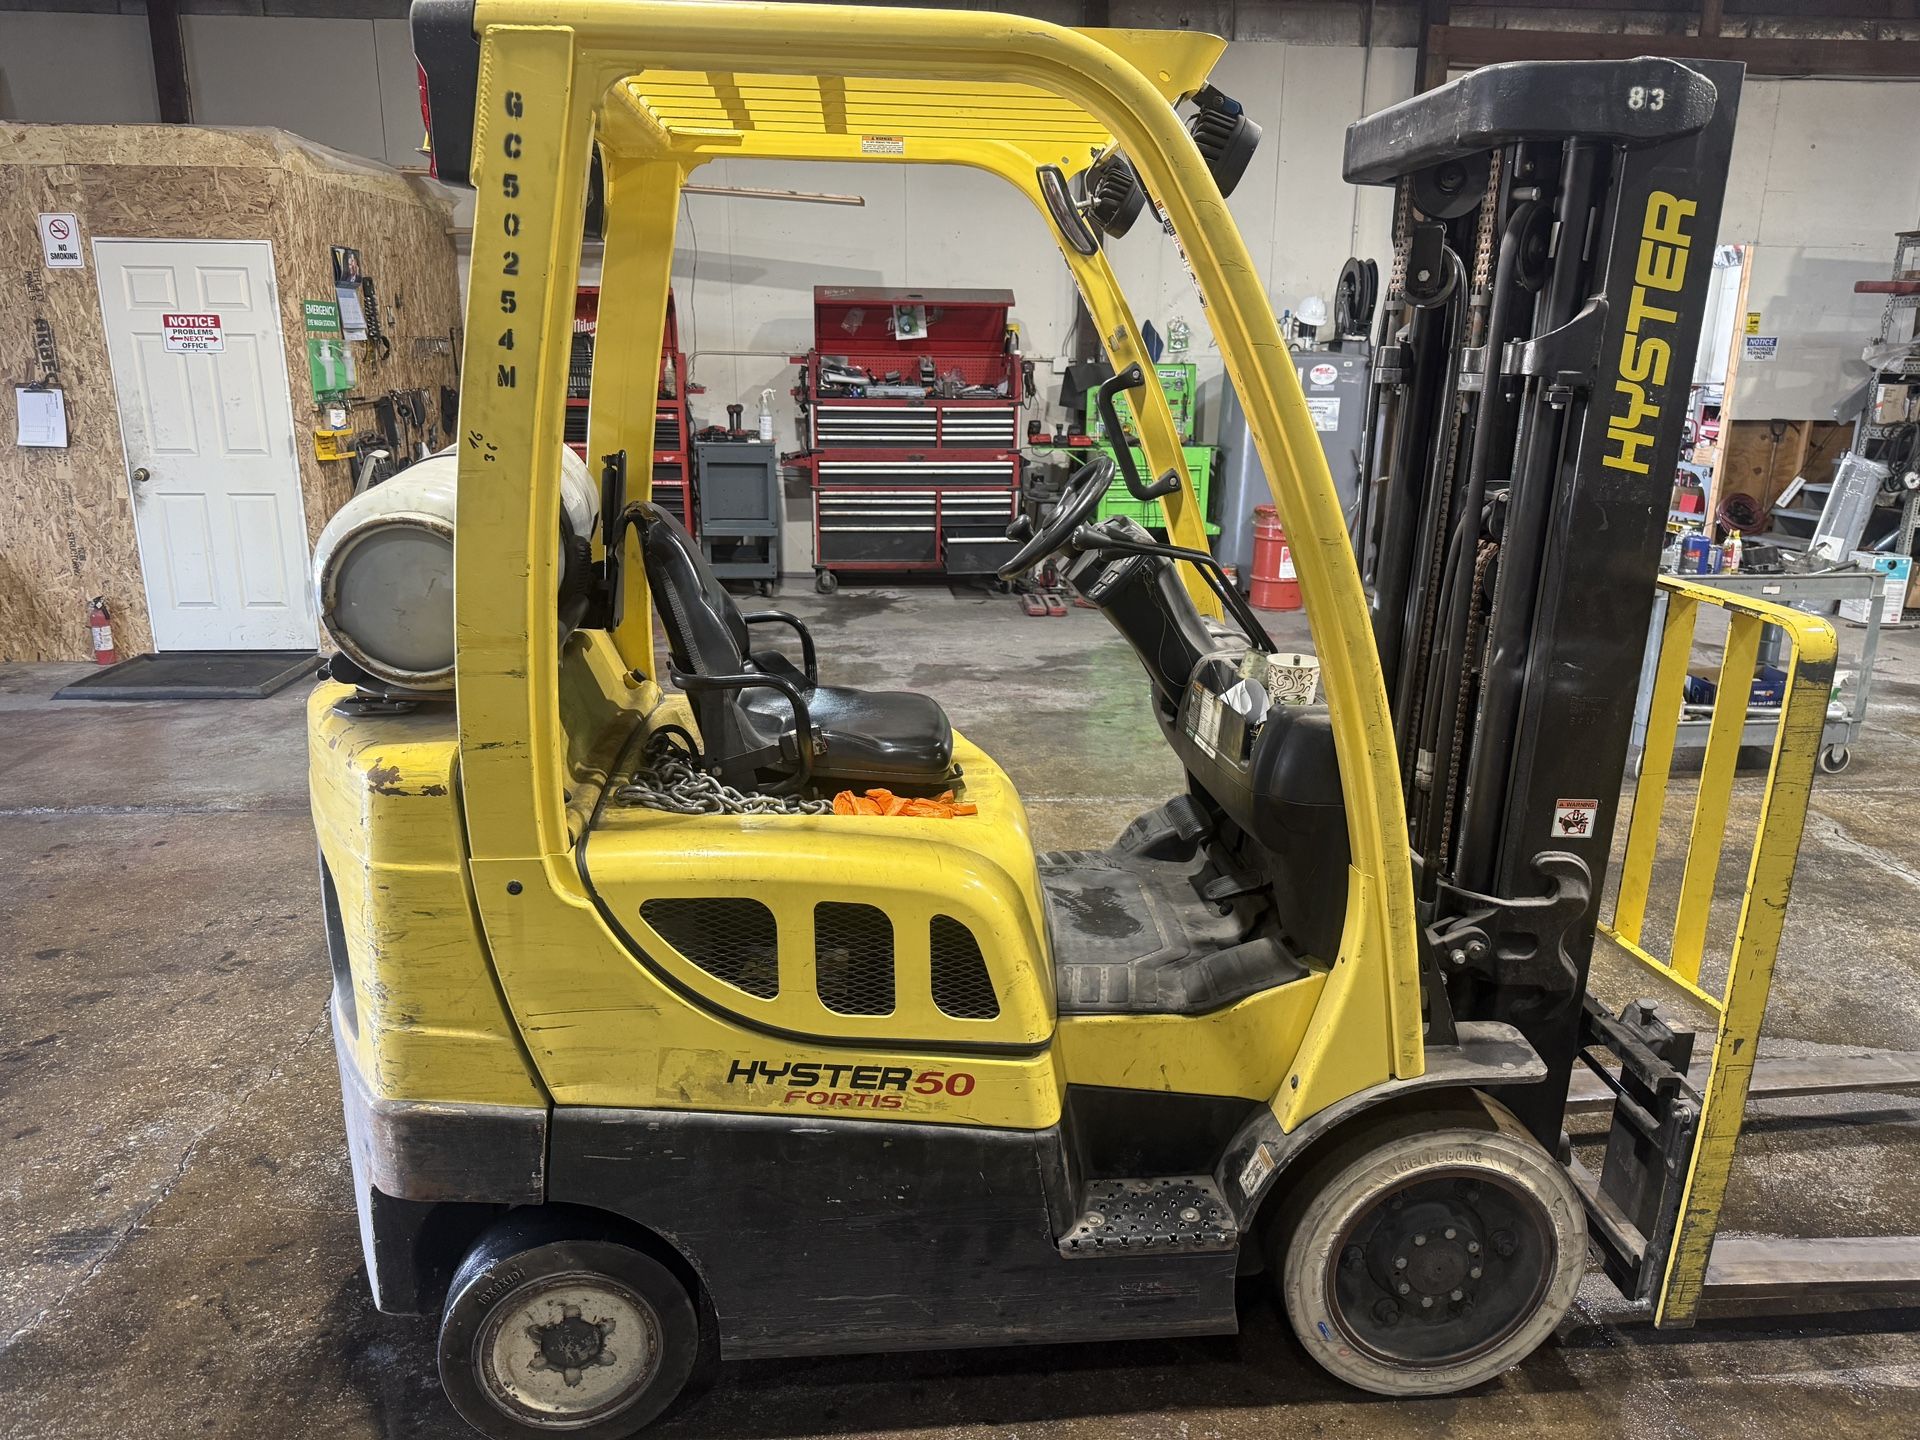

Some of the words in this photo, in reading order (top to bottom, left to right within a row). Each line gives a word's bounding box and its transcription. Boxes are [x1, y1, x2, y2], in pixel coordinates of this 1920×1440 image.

[1628, 86, 1664, 110] 83
[50, 252, 78, 260] SMOKING
[305, 304, 335, 316] EMERGENCY
[168, 316, 216, 327] NOTICE
[1602, 190, 1697, 474] HYSTER
[726, 1059, 913, 1091] HYSTER
[912, 1071, 976, 1097] 50
[783, 1090, 903, 1109] FORTIS
